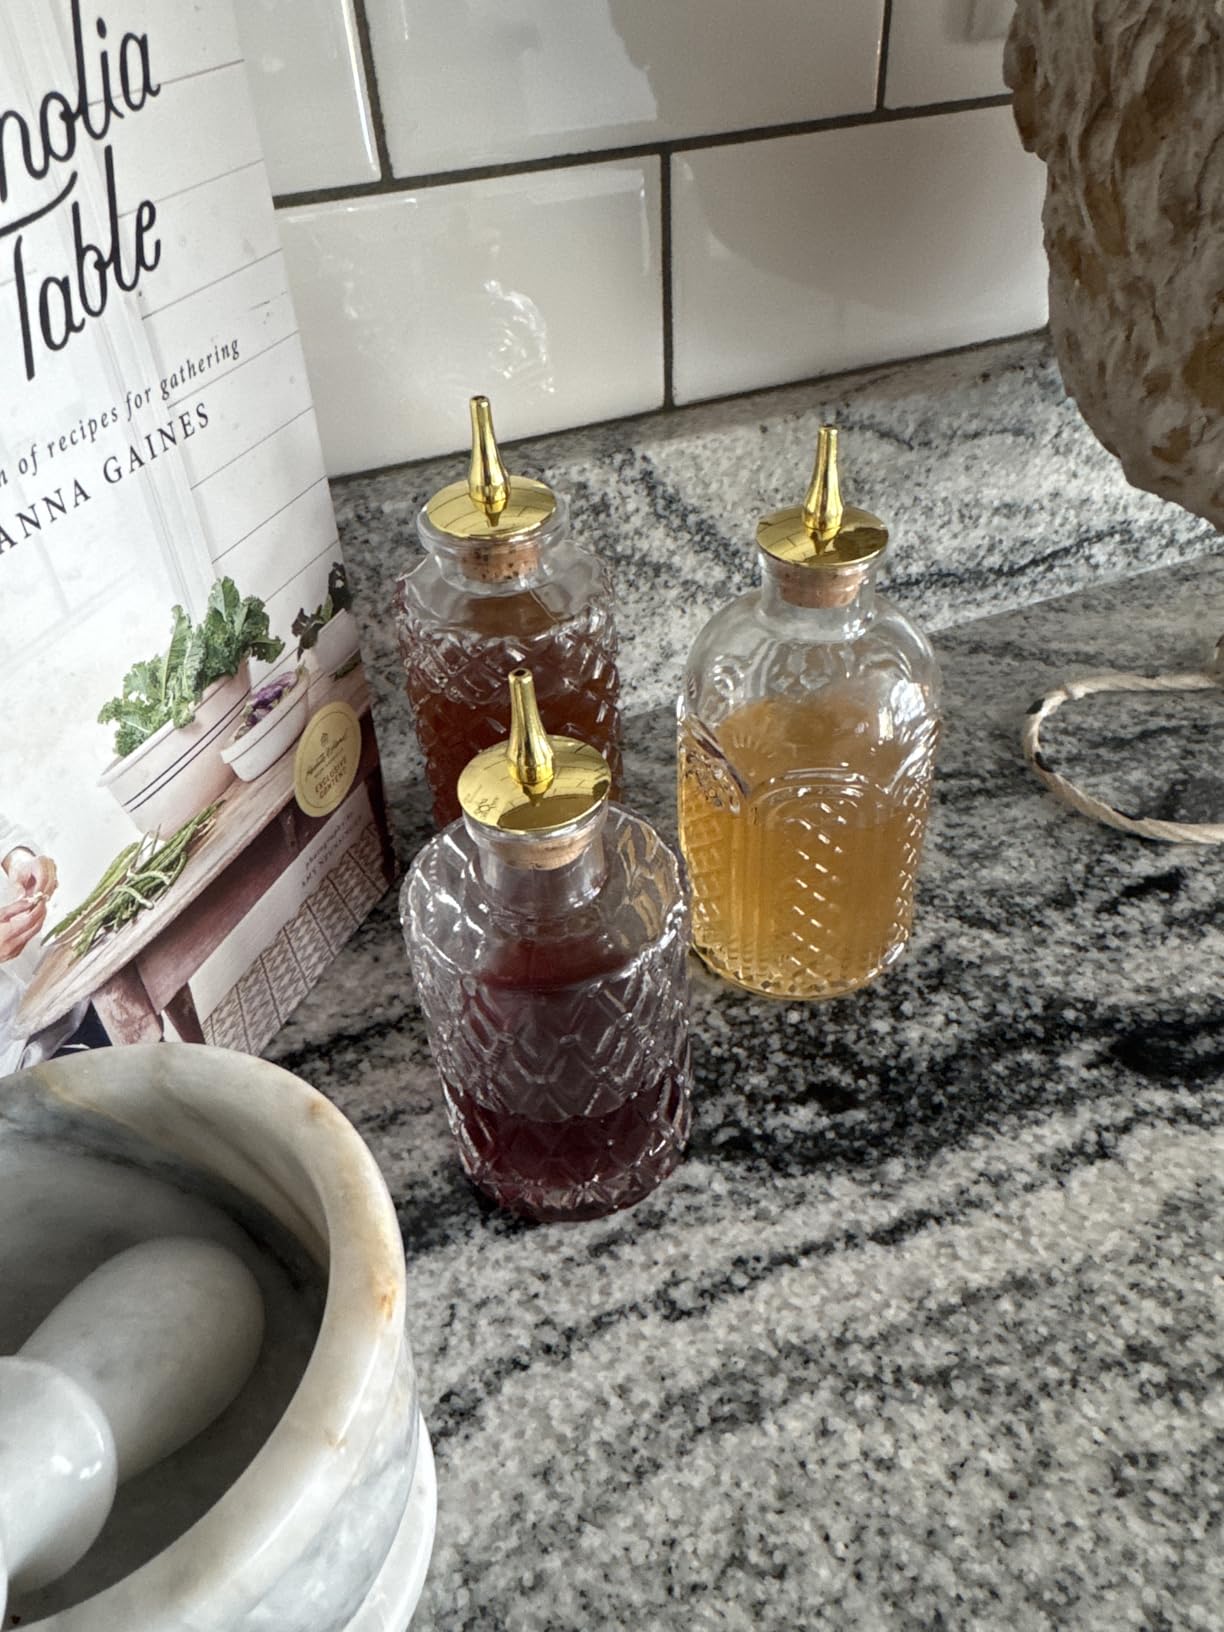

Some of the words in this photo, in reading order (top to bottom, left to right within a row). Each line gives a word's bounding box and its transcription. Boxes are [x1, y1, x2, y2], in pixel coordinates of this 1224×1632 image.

[0, 144, 161, 381] Table
[18, 443, 38, 476] of
[47, 405, 118, 458] recipes
[126, 386, 152, 421] for
[160, 338, 239, 400] gathering
[103, 402, 209, 484] GAINES
